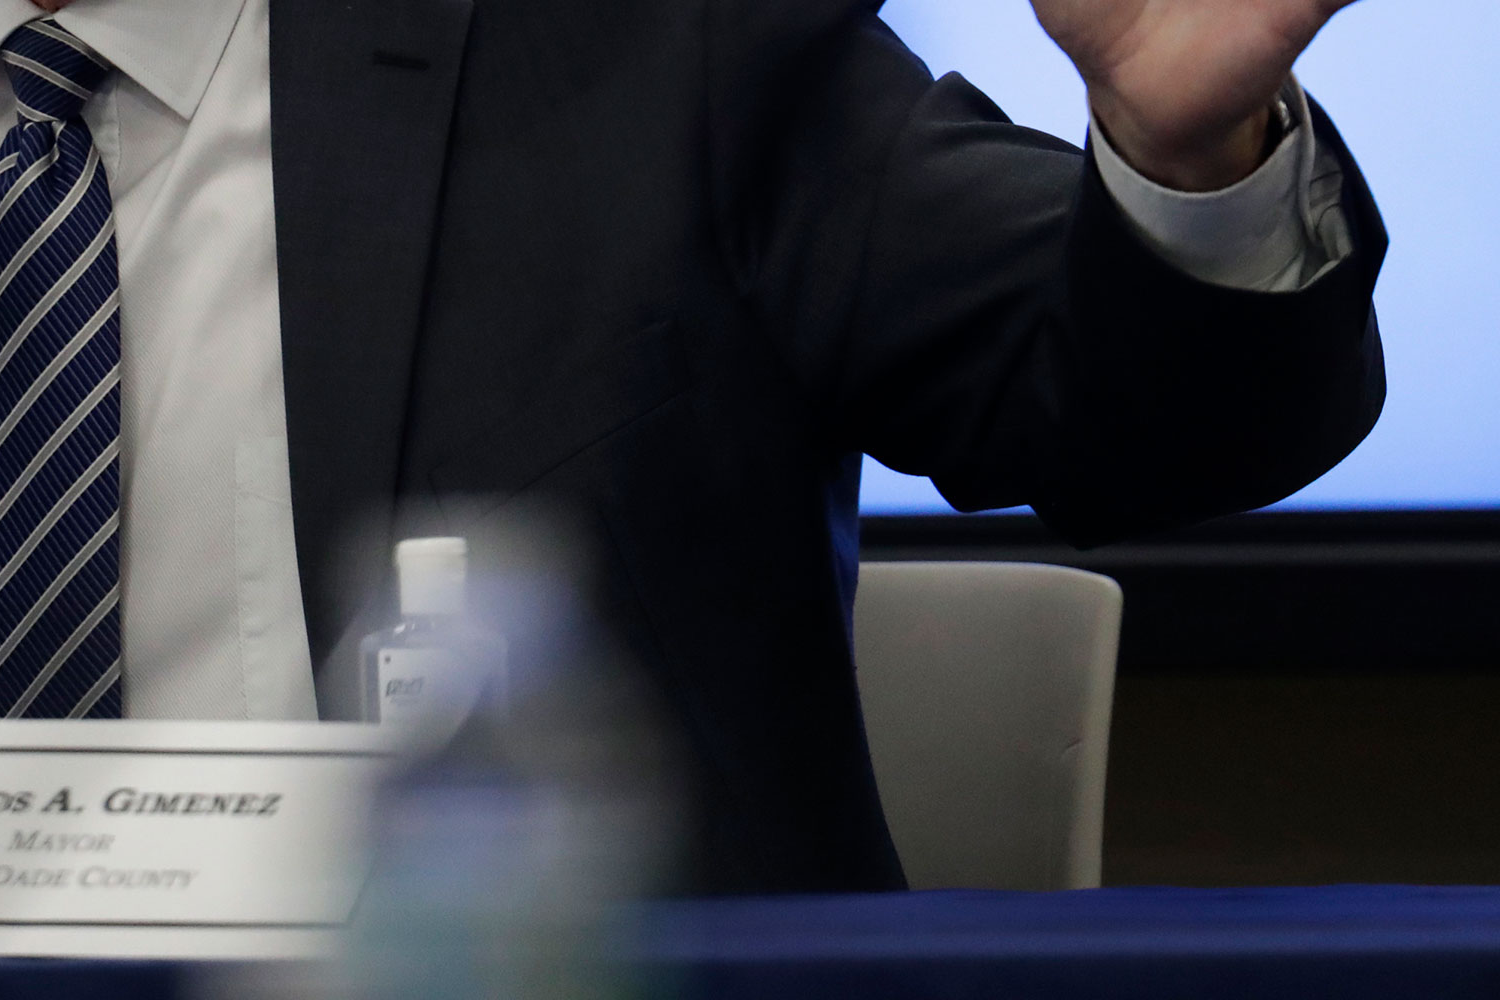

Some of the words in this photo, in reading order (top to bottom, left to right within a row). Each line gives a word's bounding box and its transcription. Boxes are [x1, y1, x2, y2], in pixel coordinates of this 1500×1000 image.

[40, 786, 84, 815] A.
[102, 786, 283, 817] GIMENEZ
[8, 829, 114, 855] MAYOR
[78, 864, 198, 890] COUNTY
